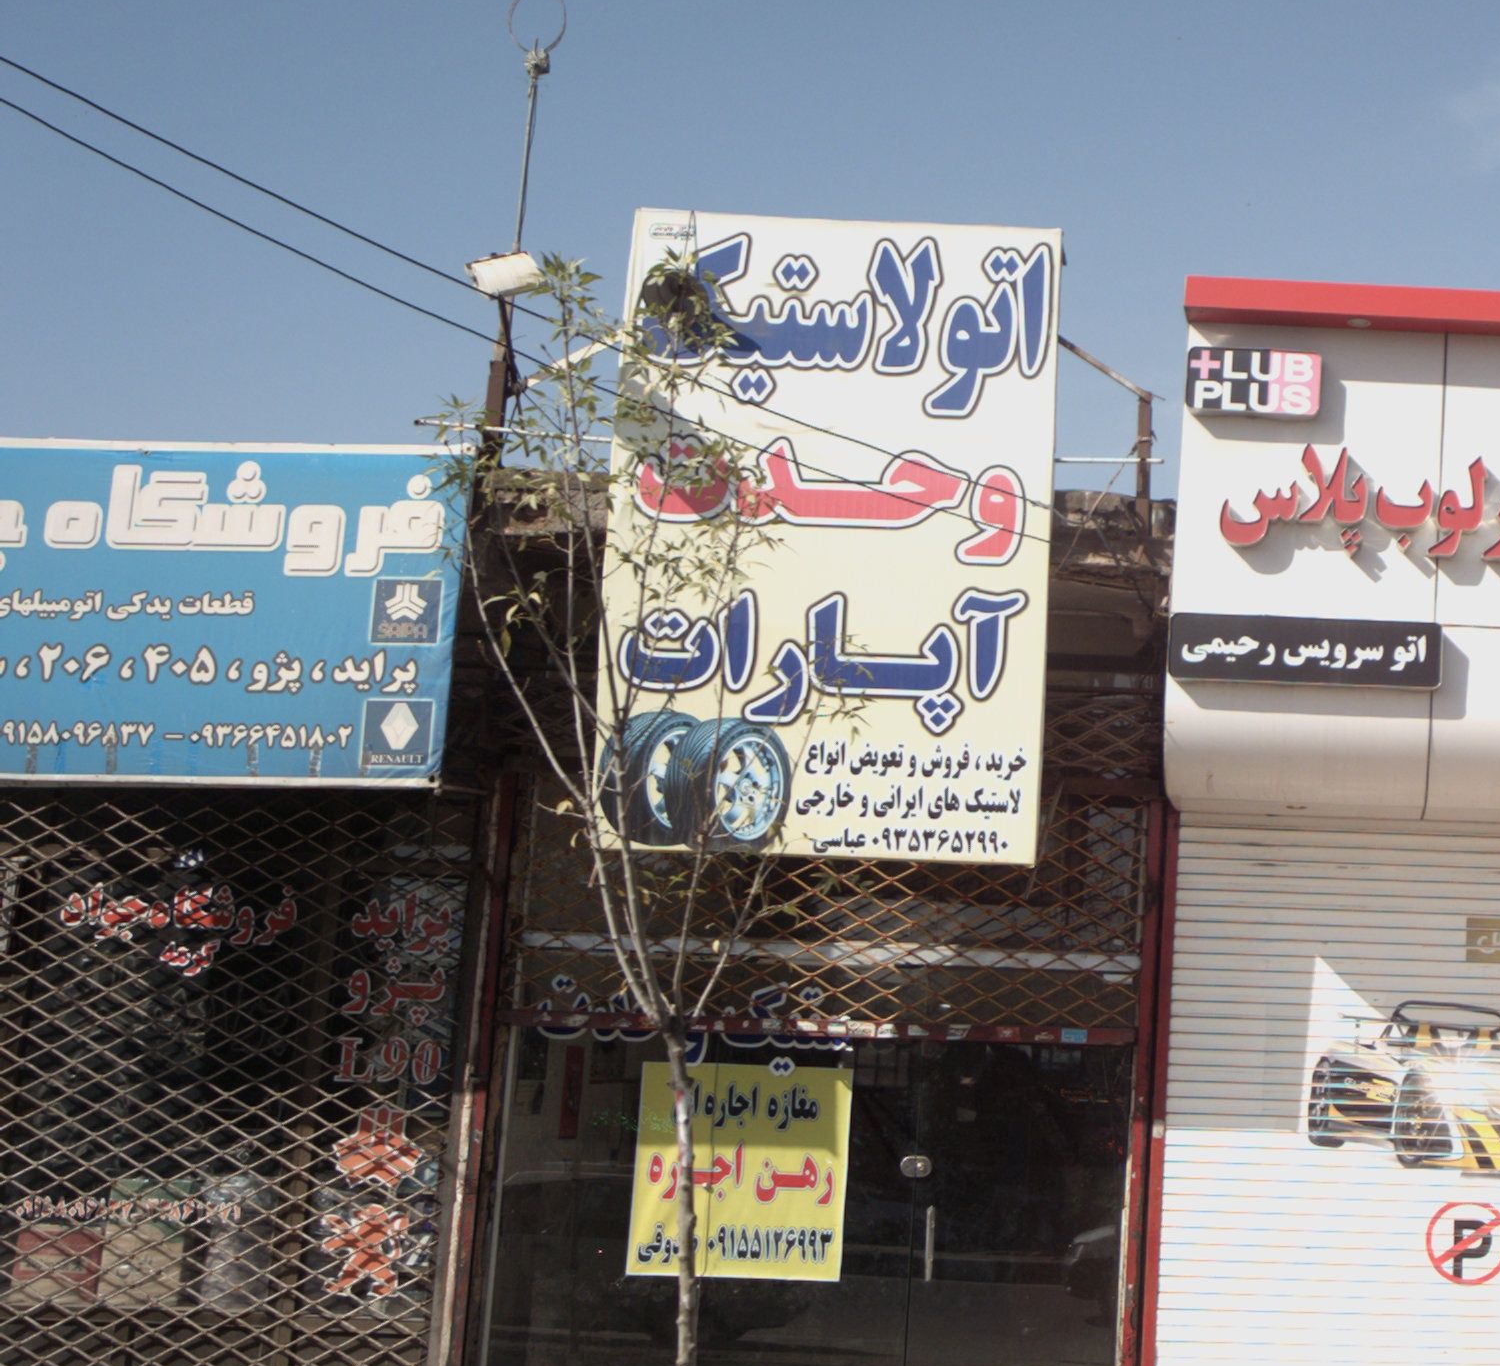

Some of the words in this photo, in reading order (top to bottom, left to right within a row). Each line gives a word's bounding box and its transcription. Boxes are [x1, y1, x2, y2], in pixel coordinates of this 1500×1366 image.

[1193, 380, 1312, 415] PLUS
[630, 435, 1026, 565] وحدت
[1219, 443, 1369, 558] پلاس
[1376, 456, 1487, 558] لوب
[44, 460, 446, 577] فروشگاه
[106, 590, 172, 621] یدکی
[177, 591, 255, 617] قطعات
[617, 587, 1030, 734] آپارات
[1181, 635, 1276, 666] رحیمی
[1283, 638, 1384, 669] سرویس
[1390, 635, 1427, 671] اتو
[189, 723, 353, 750] ۰۹۳۶۶۴۵۱۸۰۲
[371, 753, 424, 765] RENAULT
[804, 741, 846, 775] انواع
[850, 743, 904, 777] تعویض
[907, 753, 917, 778] و
[921, 743, 971, 779] فروش
[796, 783, 855, 816] خارجی
[859, 795, 869, 818] و
[873, 785, 924, 819] ایرانی
[928, 786, 961, 820] های
[965, 788, 1022, 820] لاستیک
[813, 827, 866, 853] عباسی
[872, 826, 1009, 854] ۰۹۳۵۳۶۵۲۹۹۰
[352, 892, 451, 955] پراید
[342, 956, 446, 1027] پژو
[333, 1037, 442, 1085] L90
[704, 1082, 758, 1128] اجاره
[766, 1084, 819, 1131] مغازه
[649, 1140, 744, 1202] اجره
[755, 1154, 834, 1205] رهن
[707, 1224, 834, 1264] ۰۹۱۵۵۱۲۶۹۹۳
